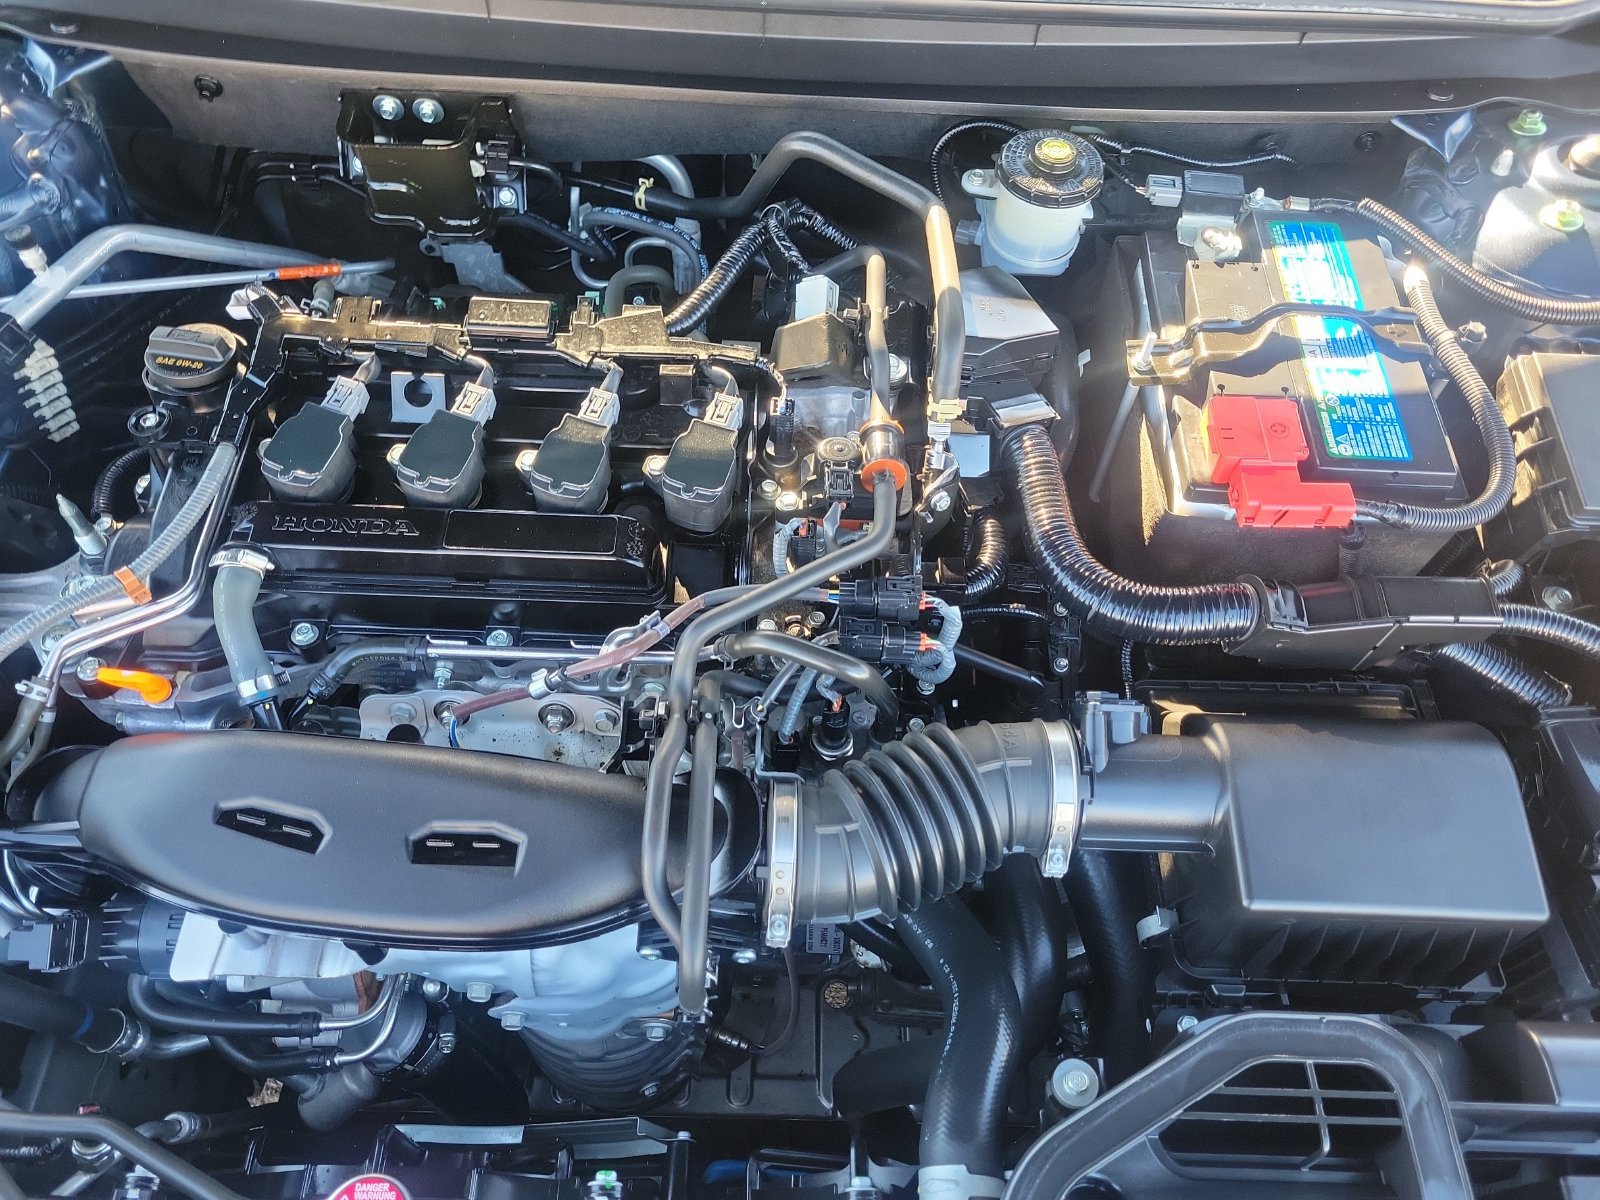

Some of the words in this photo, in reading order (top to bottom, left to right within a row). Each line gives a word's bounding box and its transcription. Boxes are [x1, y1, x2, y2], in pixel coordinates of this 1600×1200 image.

[155, 356, 176, 366] SAE
[175, 358, 204, 369] 0W-20
[271, 514, 420, 536] HONDA
[354, 1183, 391, 1191] DANGER
[353, 1191, 397, 1200] WARNUNG
